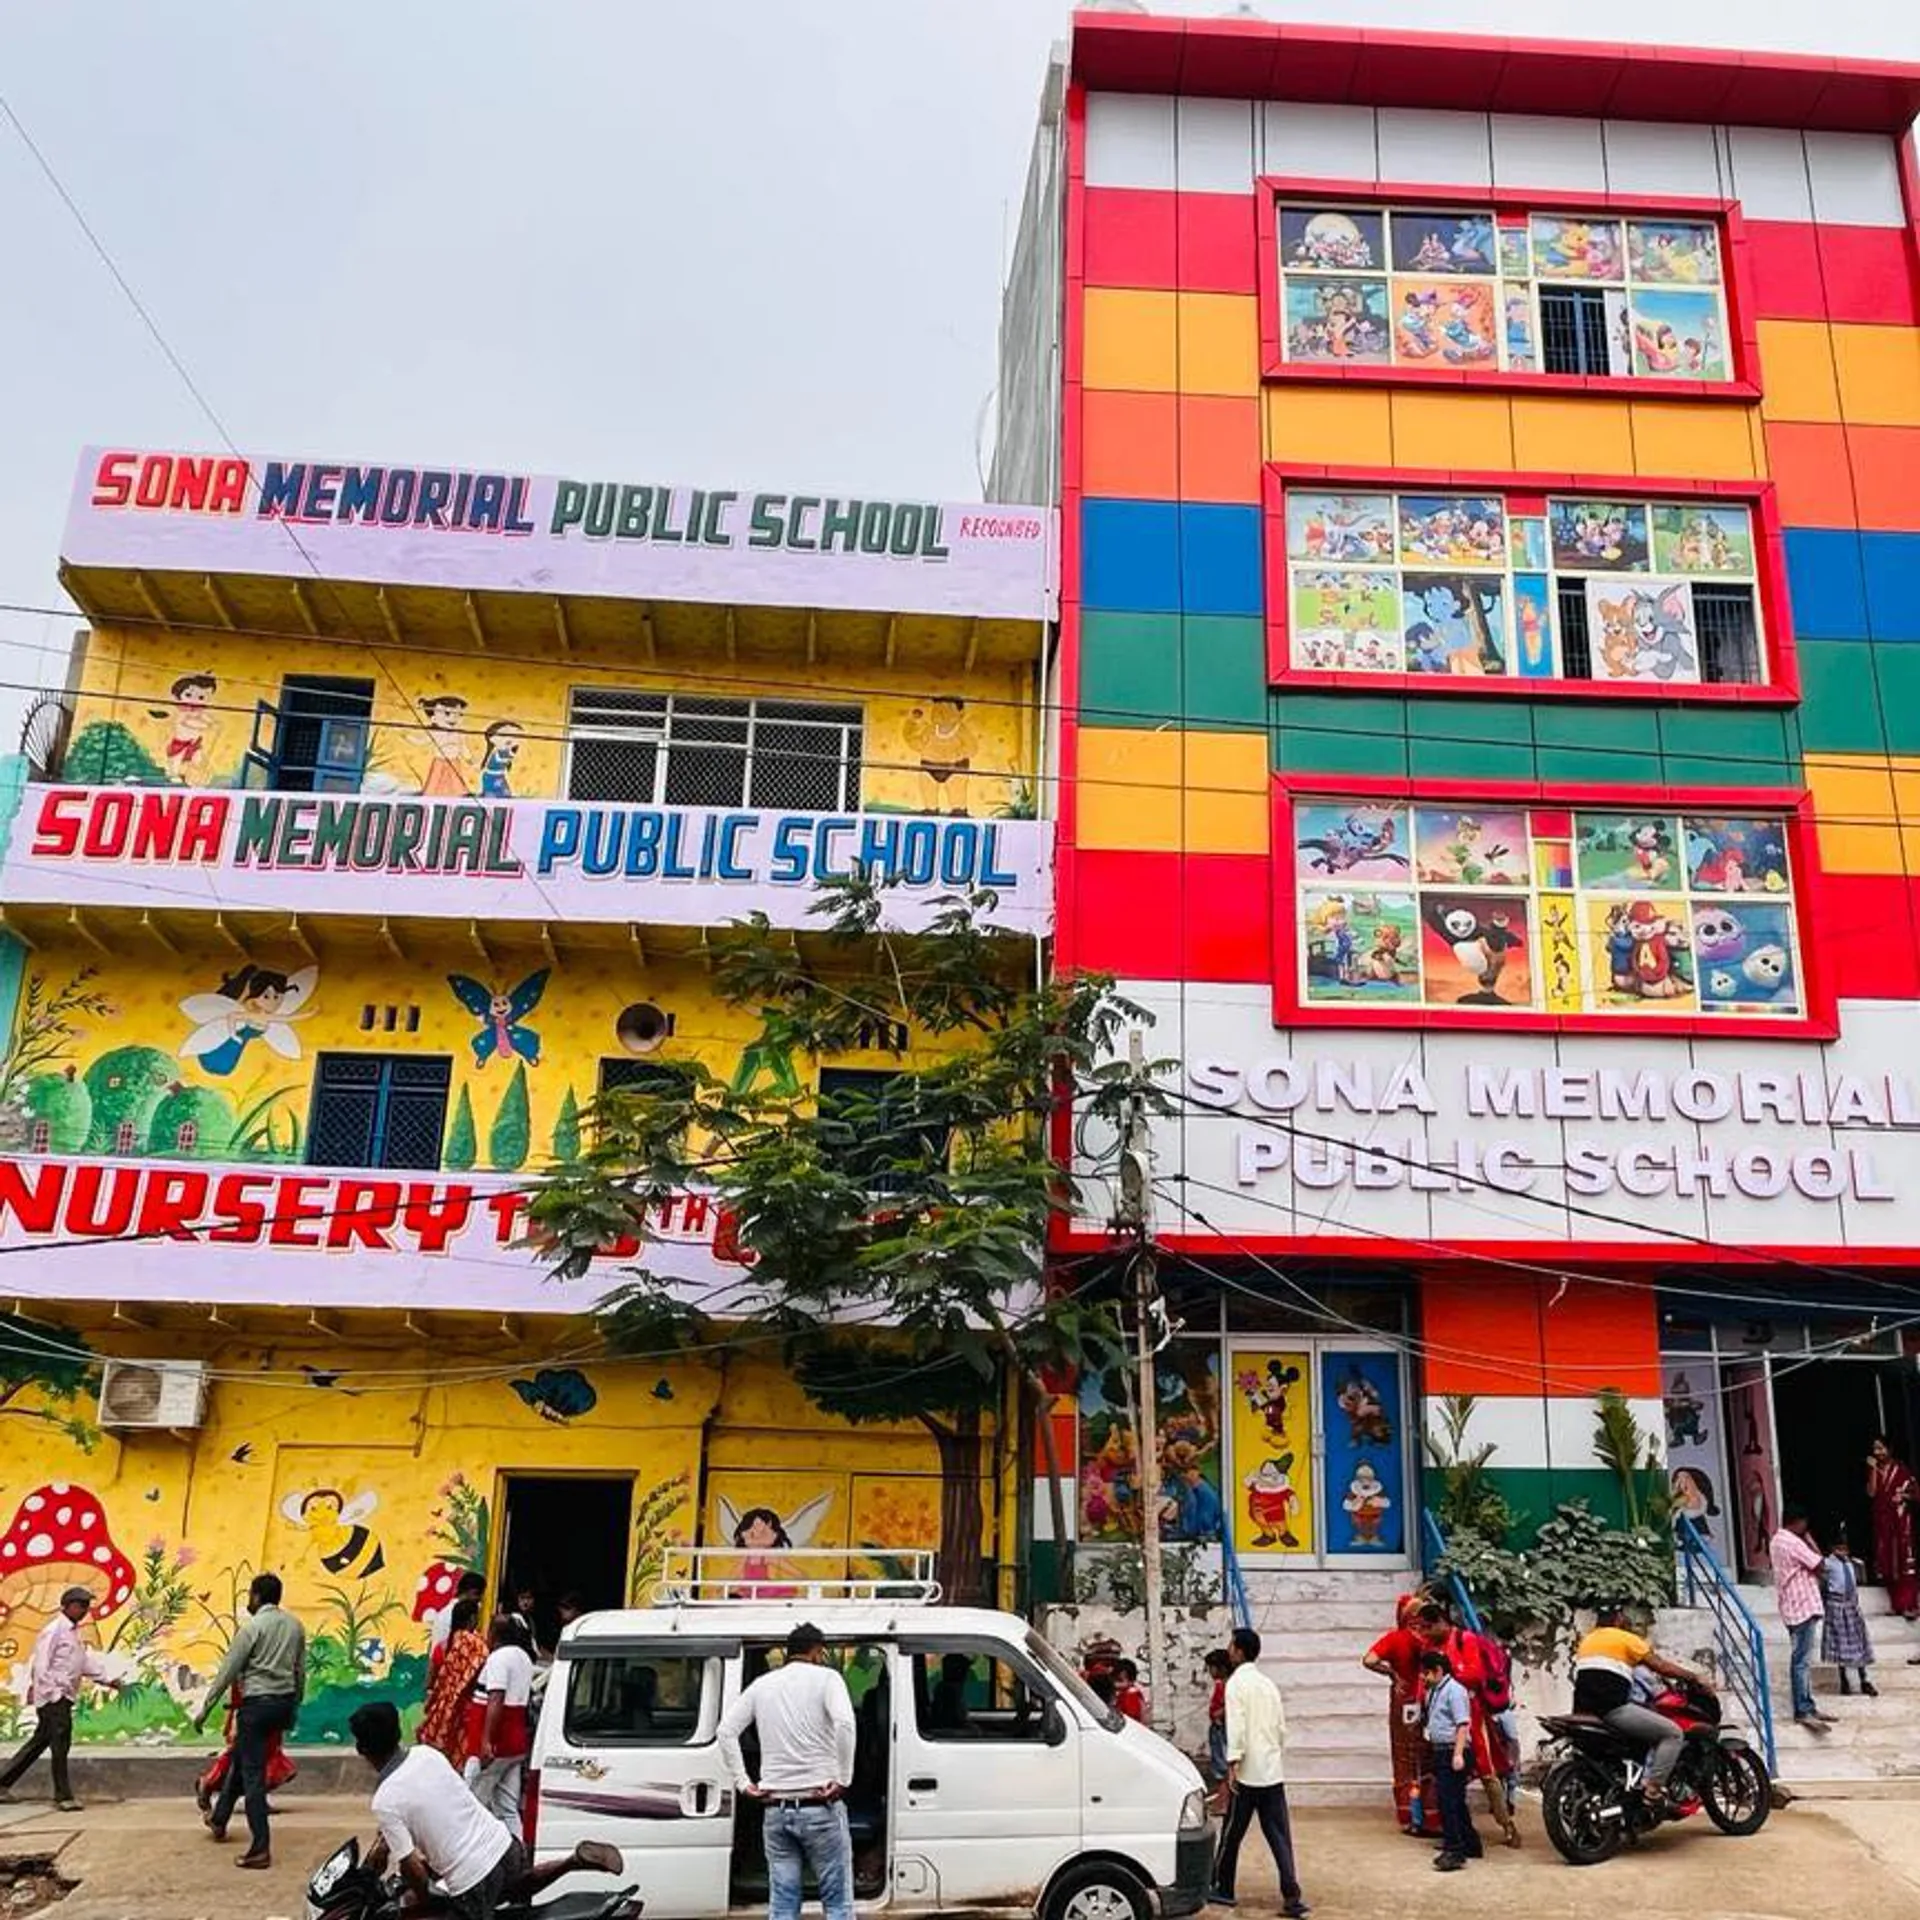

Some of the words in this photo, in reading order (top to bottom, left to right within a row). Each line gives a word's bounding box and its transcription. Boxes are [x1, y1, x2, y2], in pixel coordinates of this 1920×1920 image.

[93, 453, 250, 513] SONA
[258, 462, 535, 535] MEMORIAL
[551, 480, 738, 547] PUBLIC
[749, 493, 950, 560] SCHOOL
[31, 790, 231, 865] SONA
[233, 797, 524, 877] MEMORIAL
[536, 809, 759, 882] PUBLIC
[770, 817, 1018, 888] SCHOOL
[1188, 1055, 1437, 1115] SONA
[1466, 1064, 1920, 1126] MEMORIAL
[0, 1161, 475, 1255] NURSERY
[1236, 1130, 1535, 1193] PUBLIC
[1564, 1140, 1896, 1202] SCHOOL
